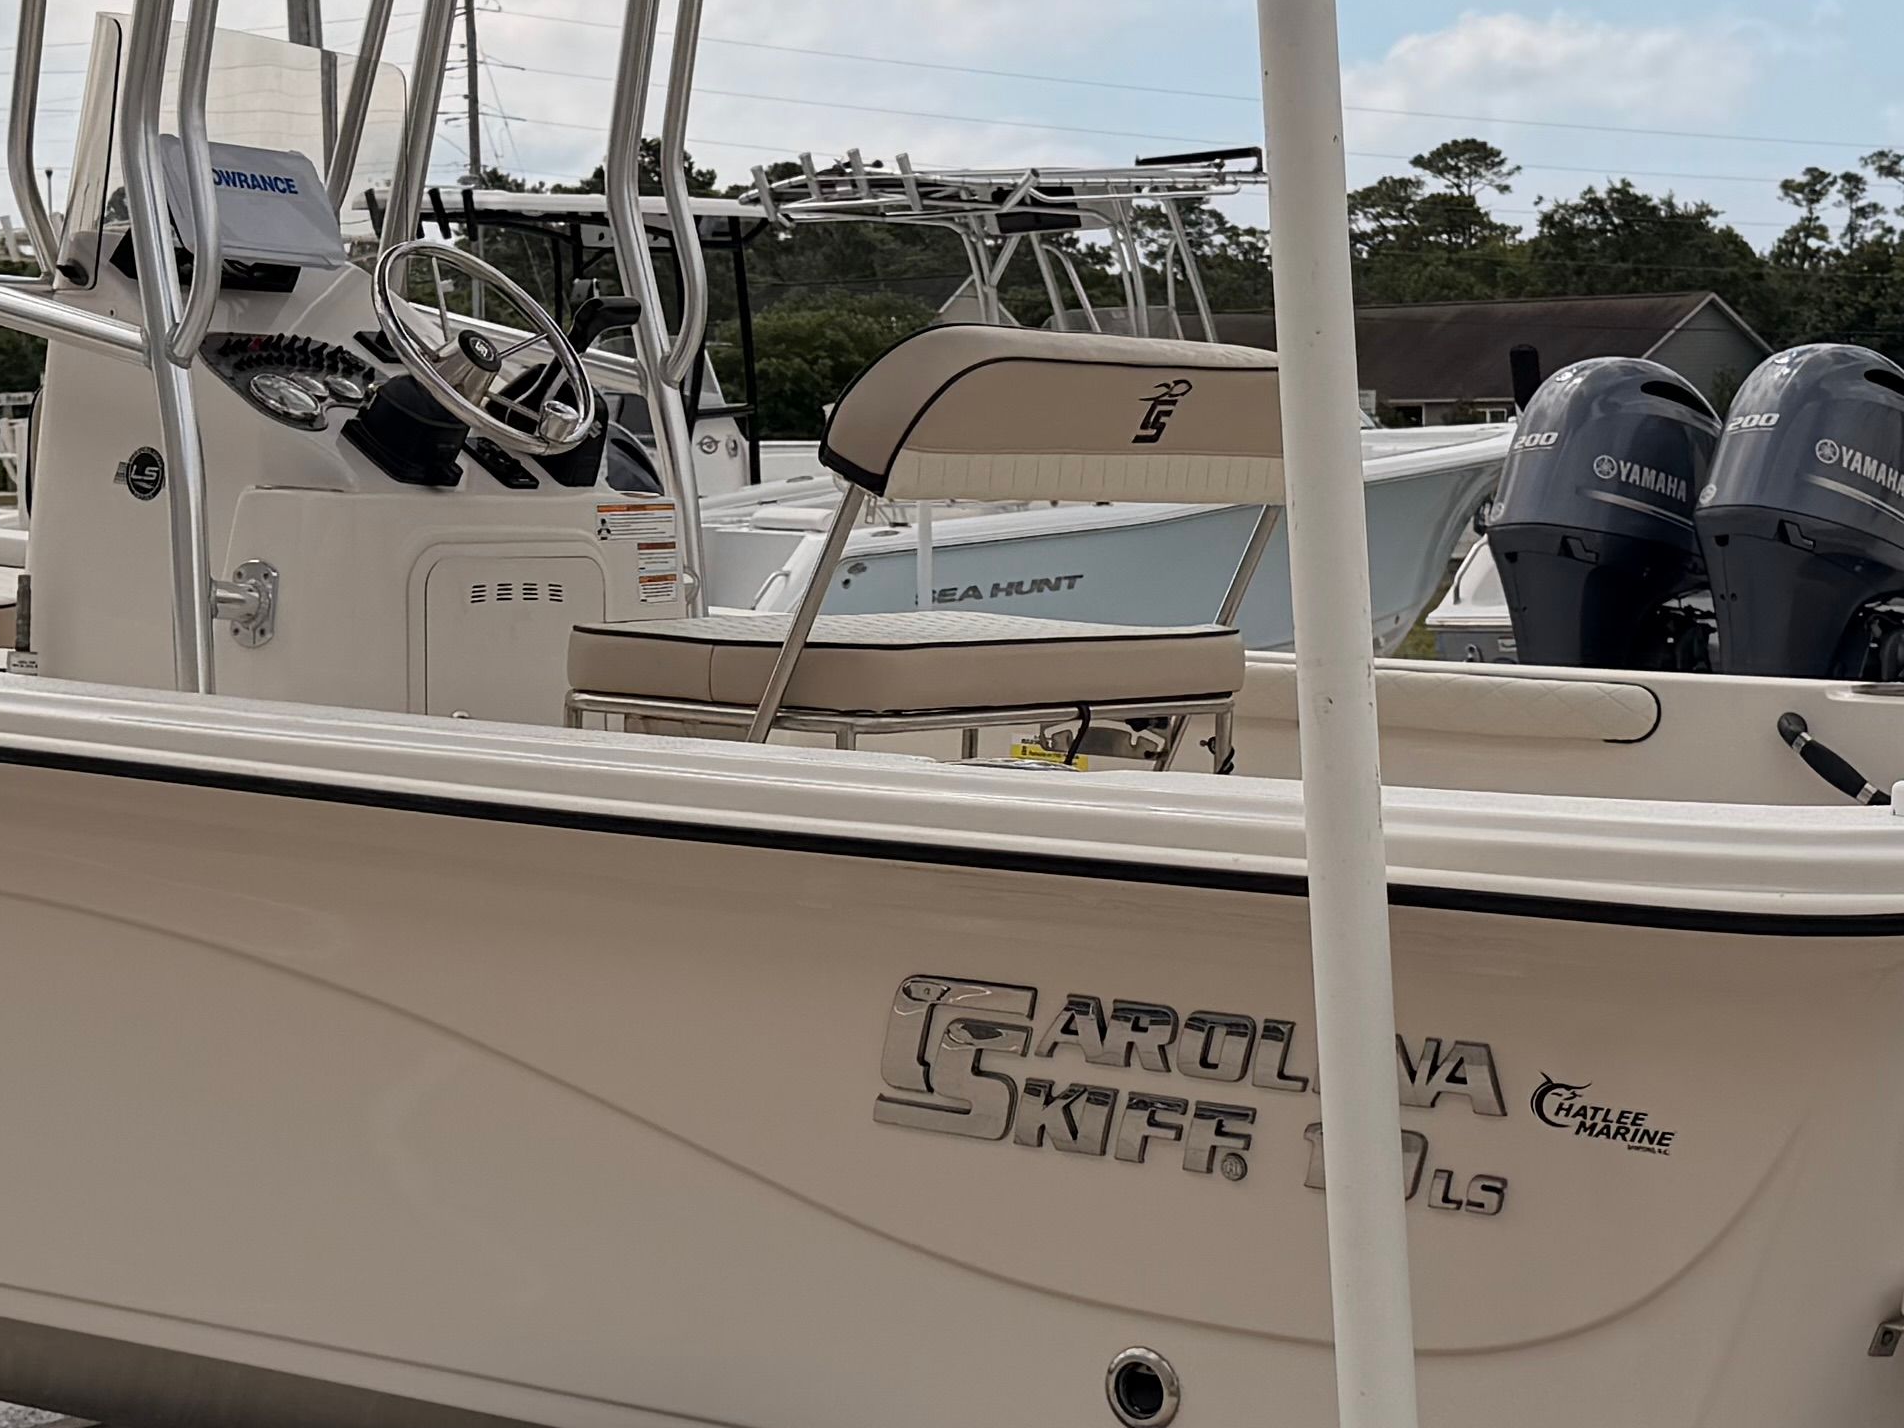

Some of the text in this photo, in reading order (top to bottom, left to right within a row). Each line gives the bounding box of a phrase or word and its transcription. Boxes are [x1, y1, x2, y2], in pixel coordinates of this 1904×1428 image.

[212, 167, 299, 195] OWRANCE
[1729, 411, 1780, 431] 200
[1513, 431, 1559, 449] 200
[130, 464, 160, 481] LS
[1618, 460, 1688, 503] YAMAHA
[990, 574, 1084, 598] HUNT
[880, 973, 1508, 1118] CAROLNA
[1530, 1072, 1649, 1128] CHATLEE
[873, 1018, 1259, 1175] SKIFF
[1427, 1168, 1509, 1216] LS
[1574, 1119, 1675, 1148] MARINE
